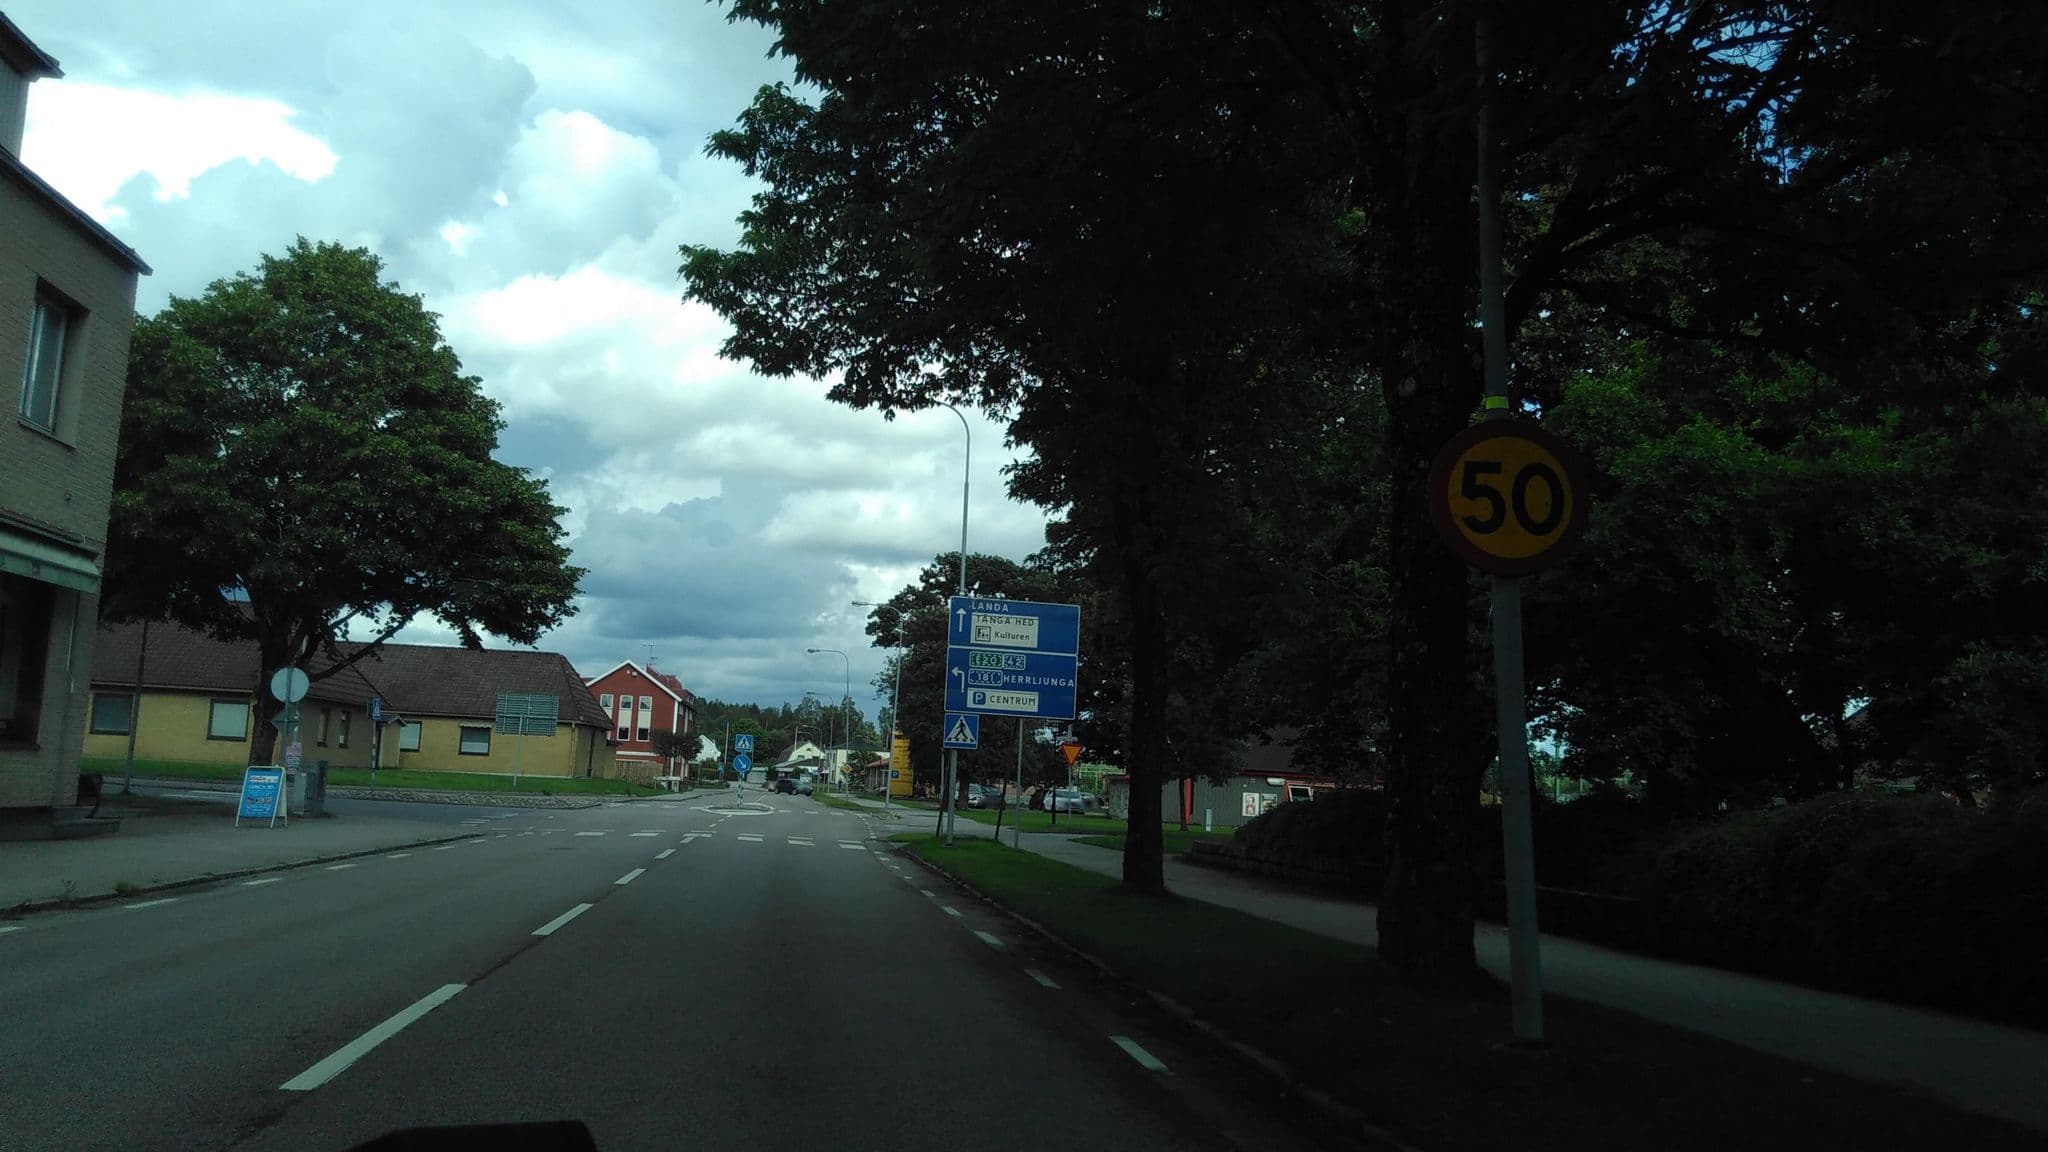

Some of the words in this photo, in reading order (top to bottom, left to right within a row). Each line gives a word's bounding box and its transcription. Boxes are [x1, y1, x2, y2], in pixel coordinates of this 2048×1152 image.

[1461, 460, 1565, 537] 50
[971, 601, 1009, 612] LANDA
[1015, 617, 1035, 627] HED
[994, 631, 1030, 640] Kulturen
[975, 655, 998, 664] E20
[1007, 656, 1022, 665] 42
[977, 673, 995, 681] 181
[1003, 674, 1075, 688] HERRLJUNGA
[975, 692, 984, 703] P
[989, 695, 1036, 706] CENTRUM
